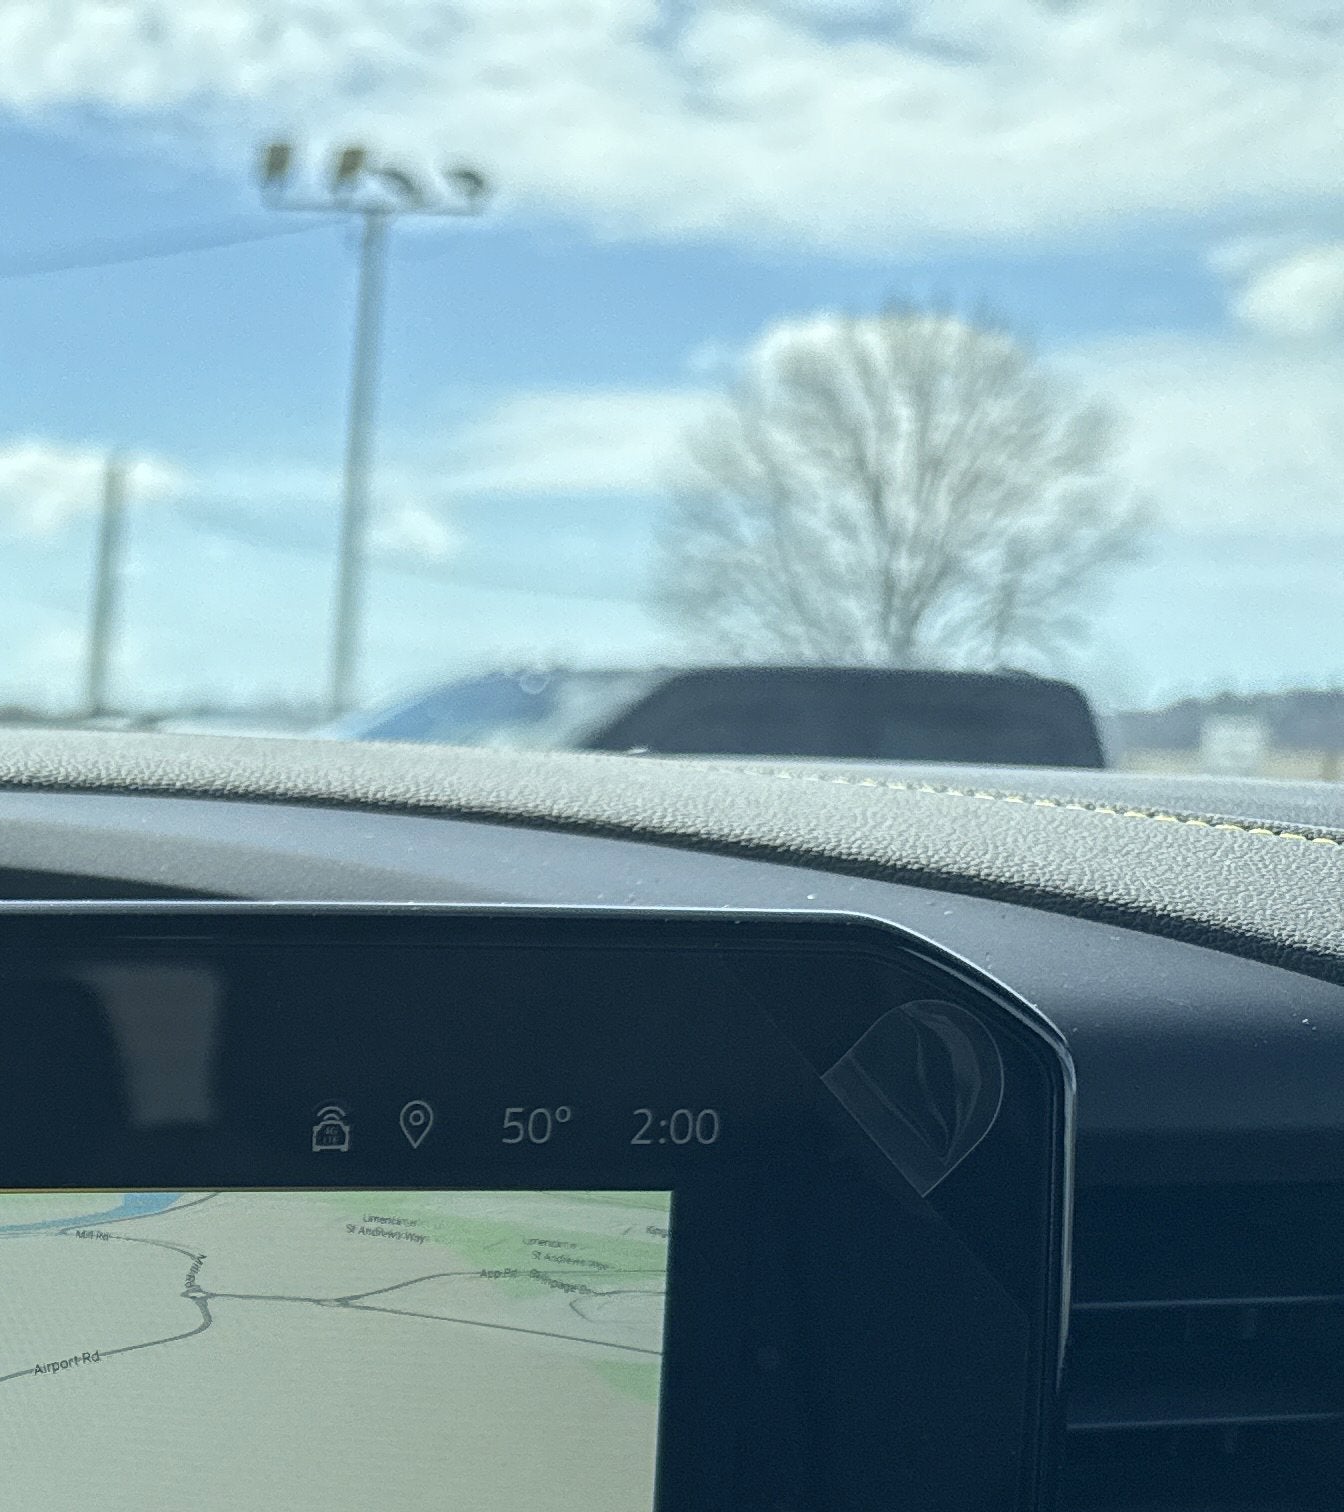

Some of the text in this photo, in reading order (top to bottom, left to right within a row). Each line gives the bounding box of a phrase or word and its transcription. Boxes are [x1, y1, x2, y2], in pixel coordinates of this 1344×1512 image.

[630, 1108, 719, 1145] 2:00
[33, 1350, 100, 1376] Airport Rd
